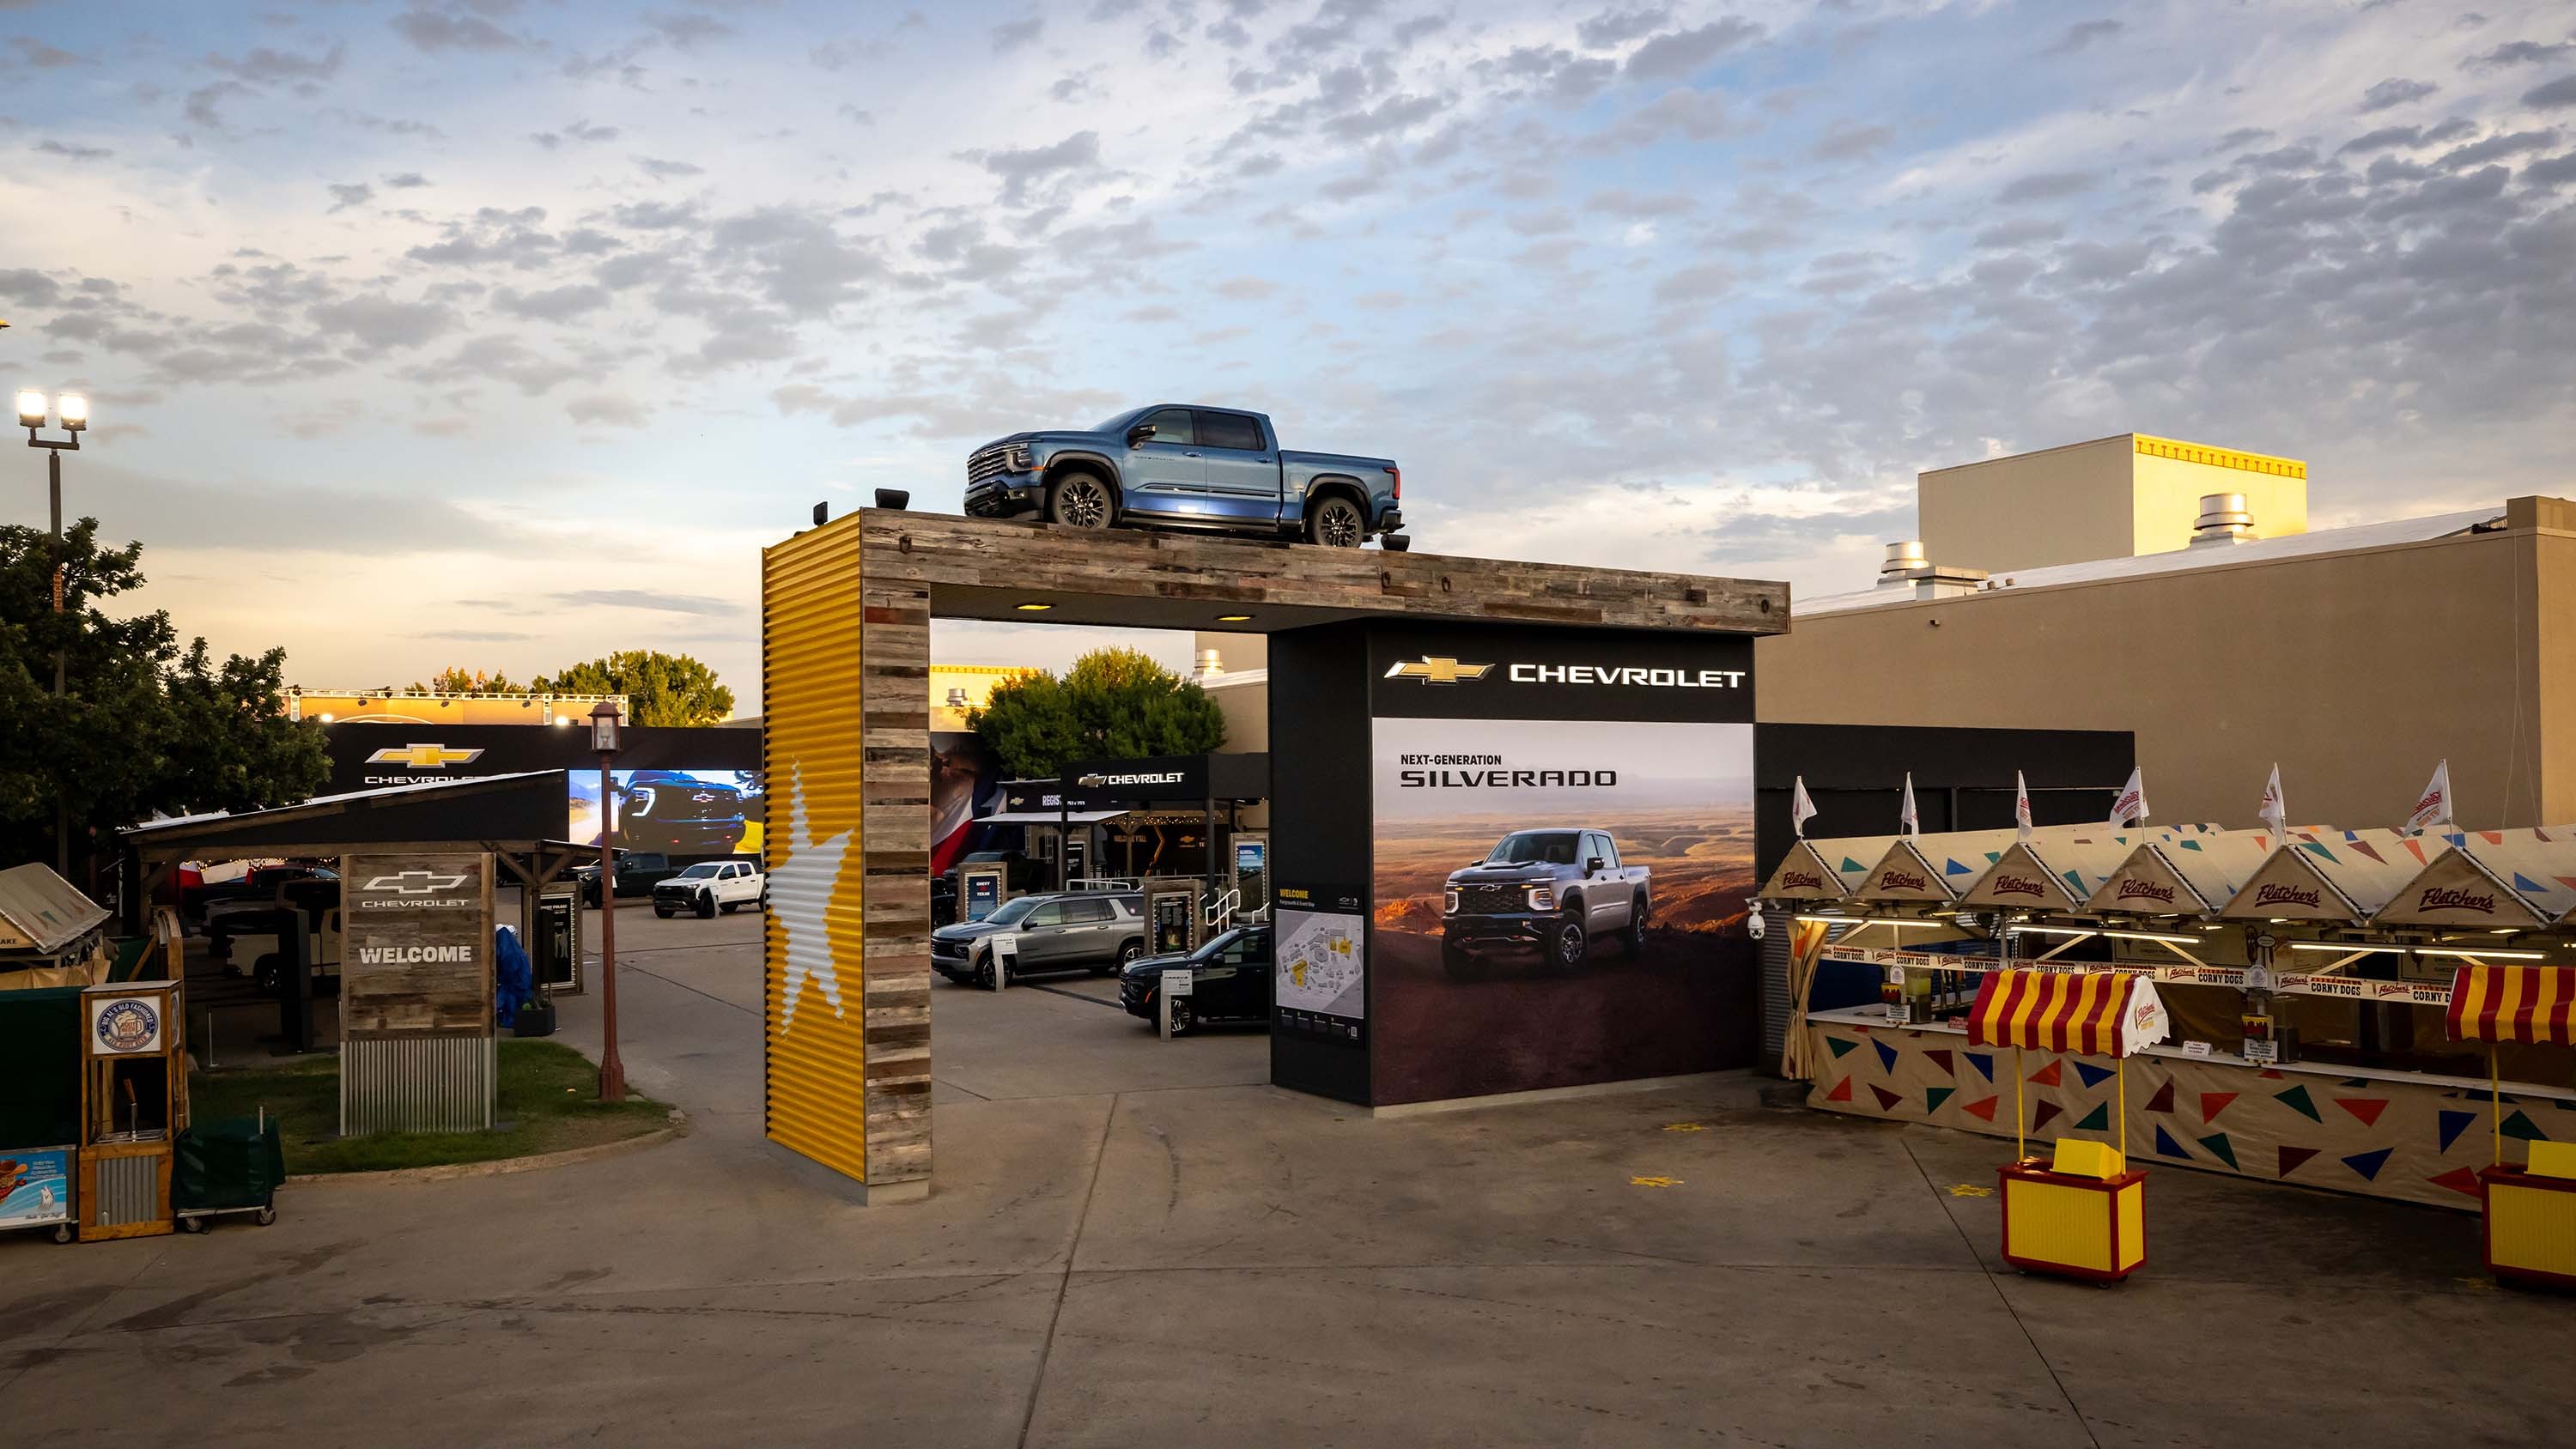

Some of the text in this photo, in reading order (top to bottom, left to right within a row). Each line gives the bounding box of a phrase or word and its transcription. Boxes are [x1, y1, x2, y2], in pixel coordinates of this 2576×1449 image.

[1510, 664, 1745, 688] CHEVROLET
[1400, 755, 1502, 765] NEXT-GENERATION
[1108, 773, 1184, 785] CHEVROLET
[1400, 770, 1617, 787] SILVERADO
[1783, 872, 1823, 889] Fletcher's
[1880, 871, 1926, 891] Fletcher's
[1993, 876, 2045, 897] Fletcher's
[1279, 888, 1309, 899] WELCOME
[2117, 879, 2174, 904] Fletcher's
[2254, 884, 2321, 907] Fletcher's
[2418, 888, 2496, 913] Fletcher's
[359, 946, 471, 964] WELCOME
[1833, 951, 1850, 960] CORNY
[1850, 952, 1865, 961] DOGS
[1896, 956, 1915, 965] CORNY
[1916, 957, 1930, 966] DOGS
[1964, 961, 1984, 969] CORNY
[1984, 961, 2000, 970] DOGS
[2058, 966, 2075, 974] DOGS
[2169, 967, 2196, 979] Fletcher's
[2198, 973, 2223, 983] CORNY
[2224, 974, 2244, 985] DOGS
[2280, 975, 2309, 988] Fletcher's
[2311, 983, 2338, 994] CORNY
[2340, 984, 2360, 996] DOGS
[2379, 982, 2410, 997] Fletcher's
[2413, 990, 2442, 1002] CORNY
